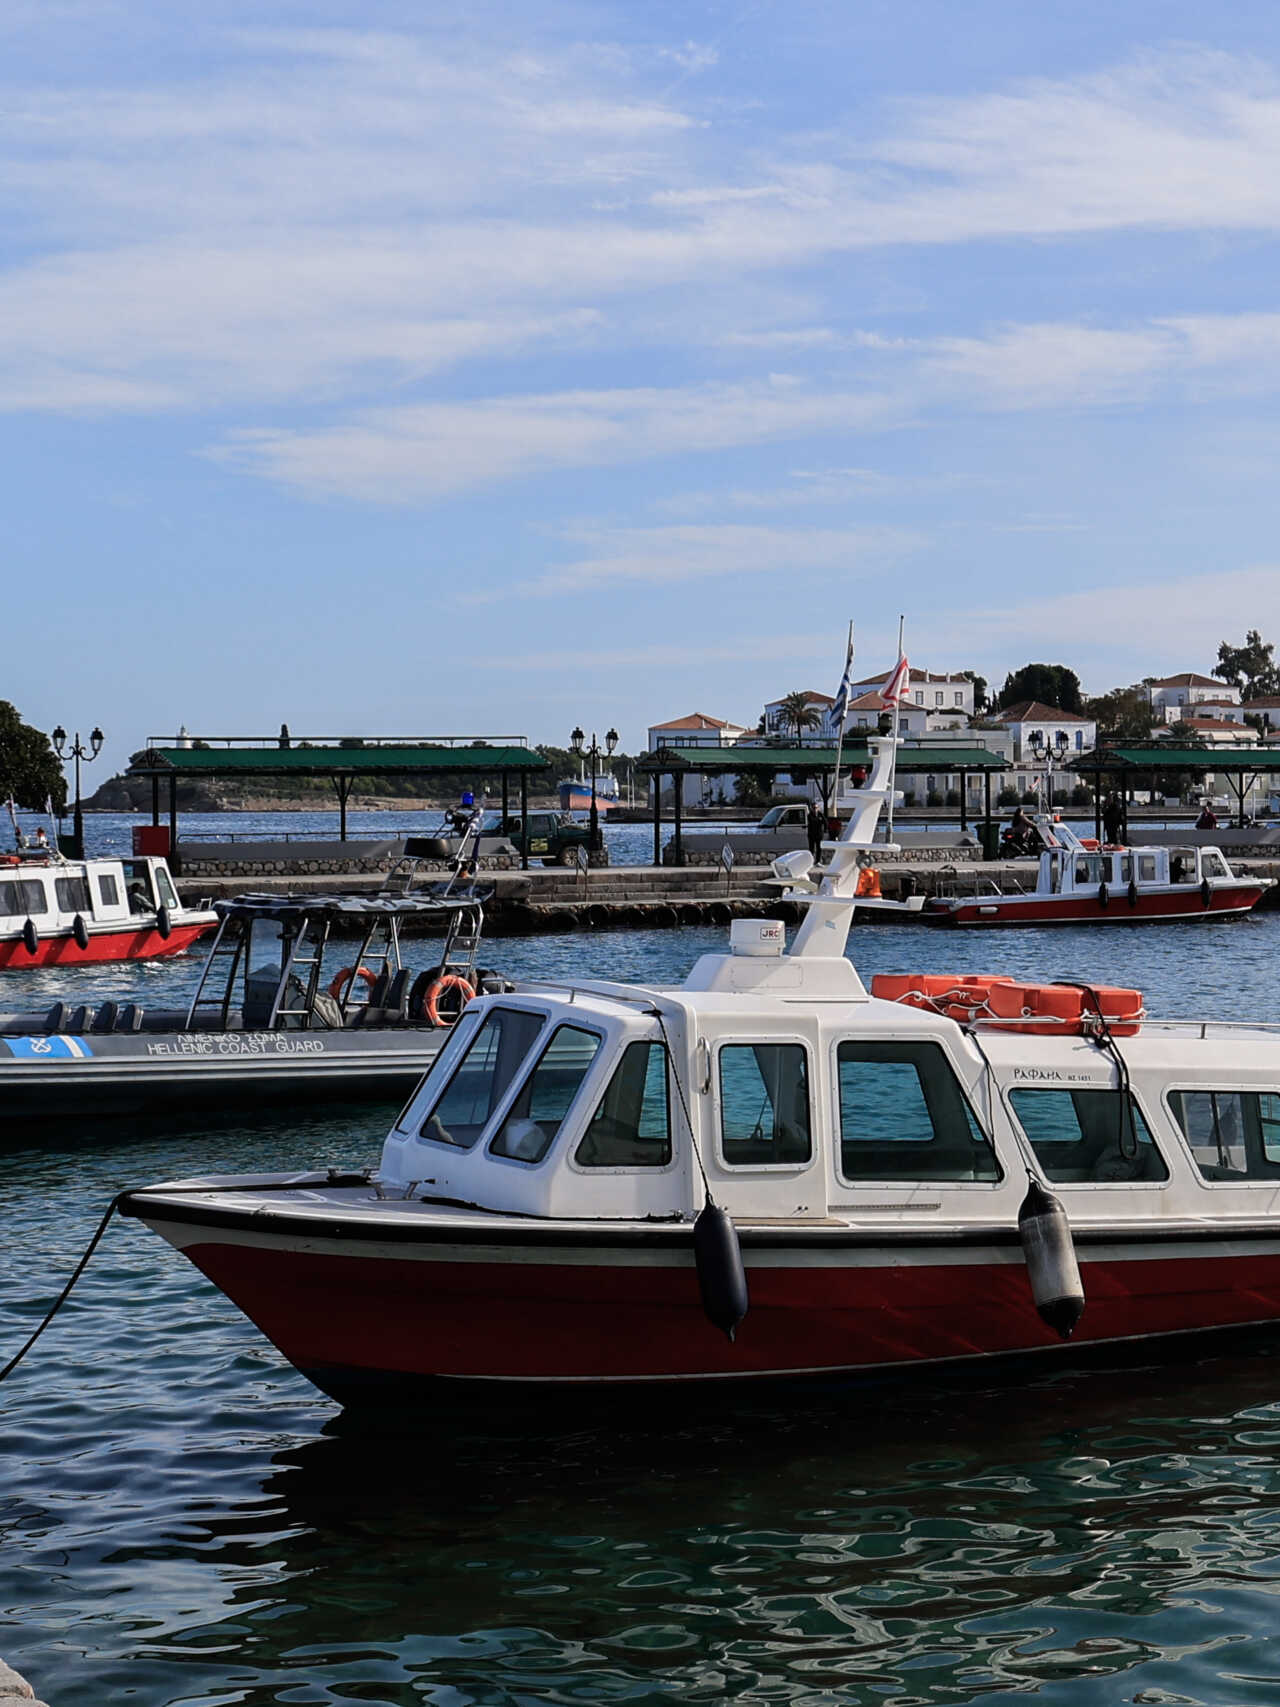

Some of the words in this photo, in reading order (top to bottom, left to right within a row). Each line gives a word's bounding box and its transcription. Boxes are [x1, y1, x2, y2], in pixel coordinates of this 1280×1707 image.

[147, 1043, 213, 1055] HELLENIC
[219, 1042, 267, 1054] COAST
[276, 1040, 324, 1052] GUARD
